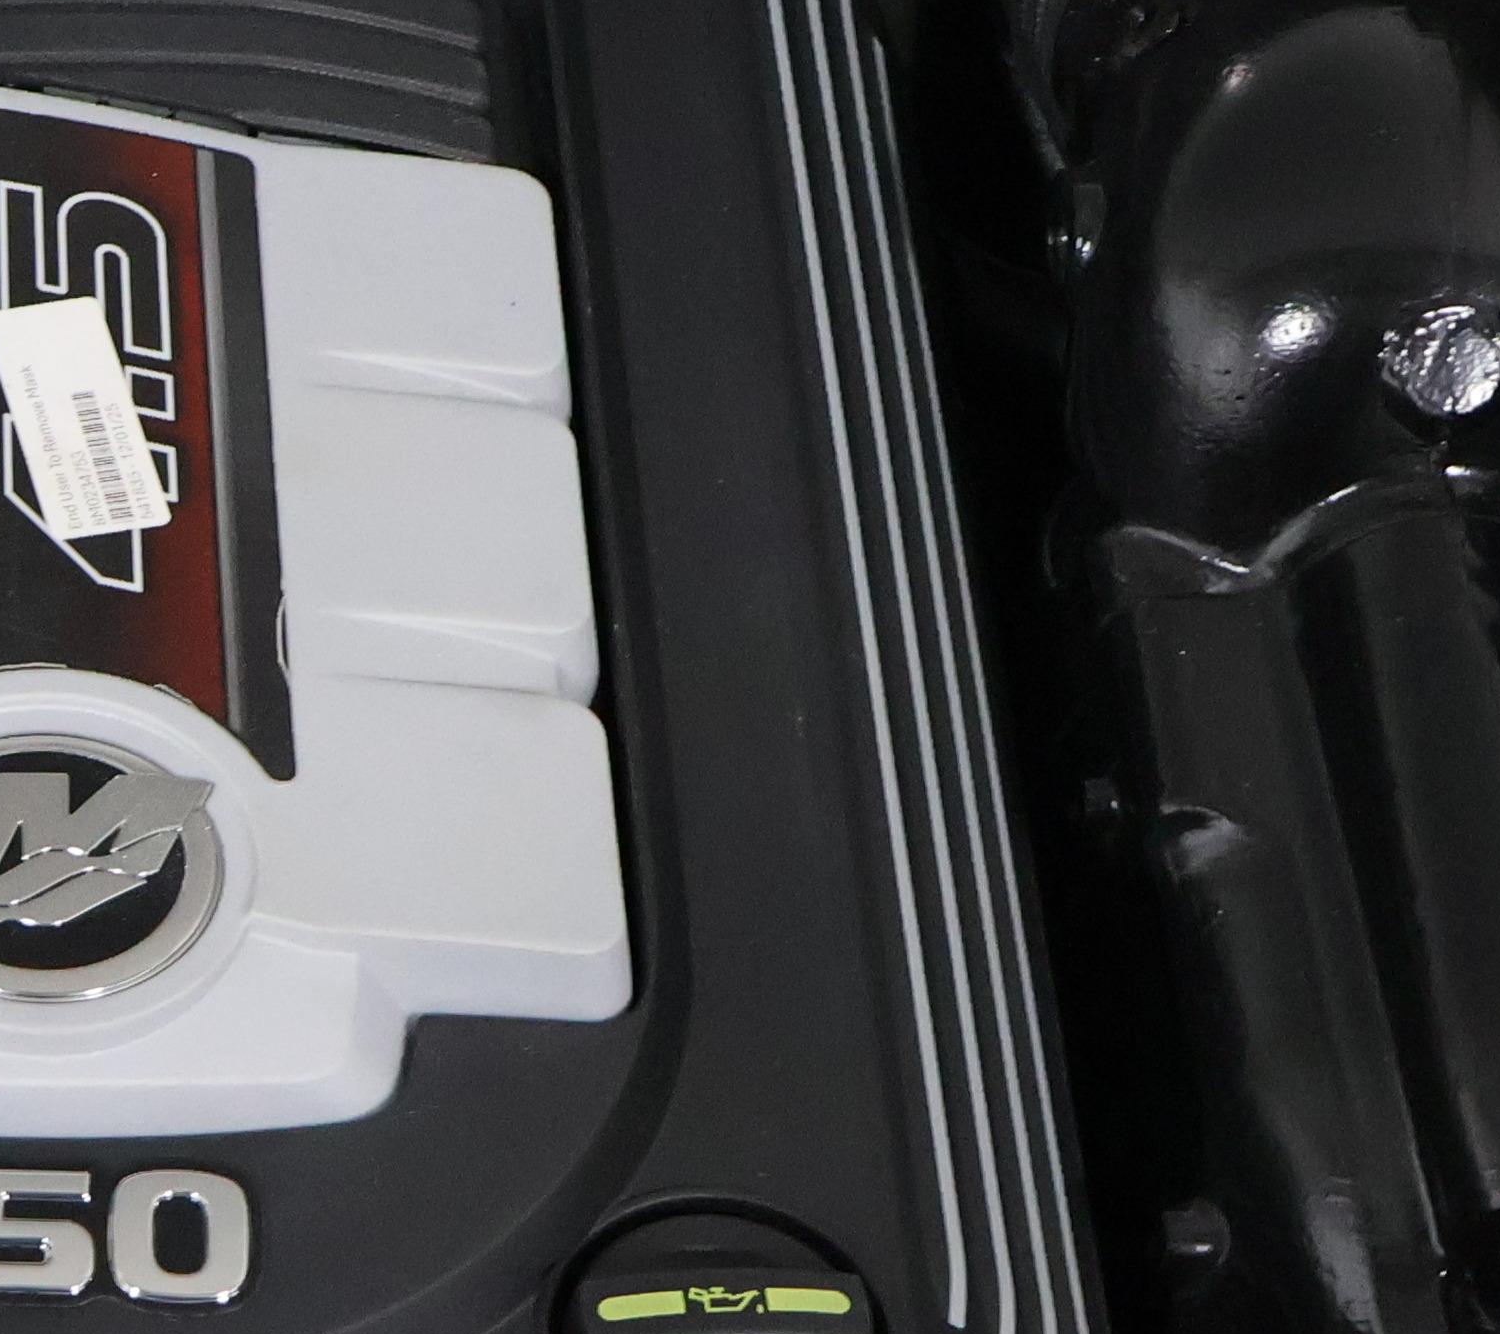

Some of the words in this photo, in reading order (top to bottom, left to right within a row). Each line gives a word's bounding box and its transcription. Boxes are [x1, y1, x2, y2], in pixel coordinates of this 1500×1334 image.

[19, 364, 41, 399] Mask
[32, 400, 58, 452] Remove
[55, 472, 75, 503] User
[61, 504, 83, 530] End
